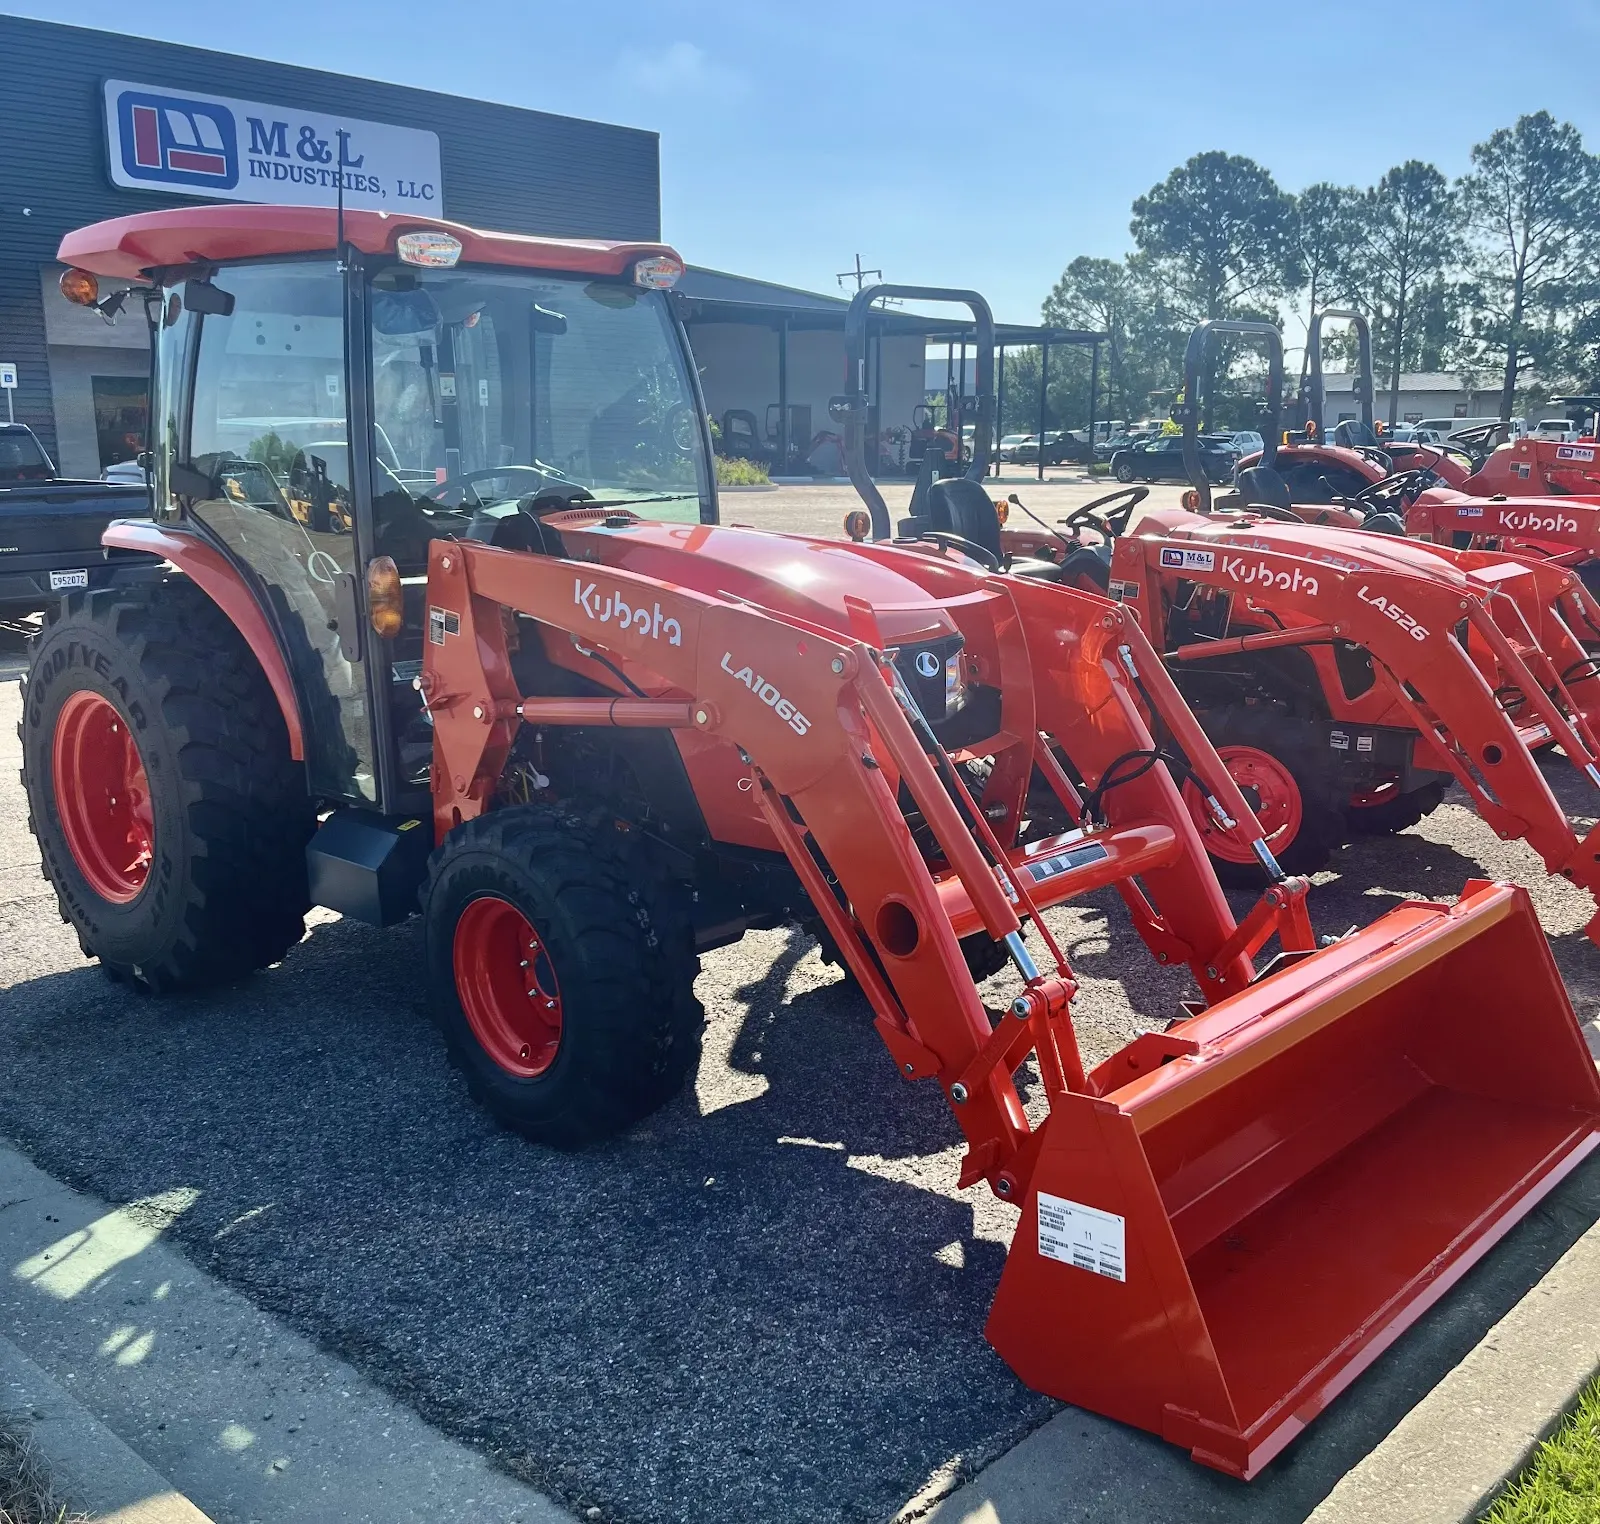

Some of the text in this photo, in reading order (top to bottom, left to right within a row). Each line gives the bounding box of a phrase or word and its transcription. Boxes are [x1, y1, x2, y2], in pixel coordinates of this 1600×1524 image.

[248, 159, 434, 200] INDUSTRIES, LLC
[1499, 511, 1578, 532] Kubota
[1221, 556, 1319, 596] Kubota
[574, 578, 682, 647] Kubota
[1357, 585, 1431, 641] LA526
[720, 652, 812, 736] LA1065
